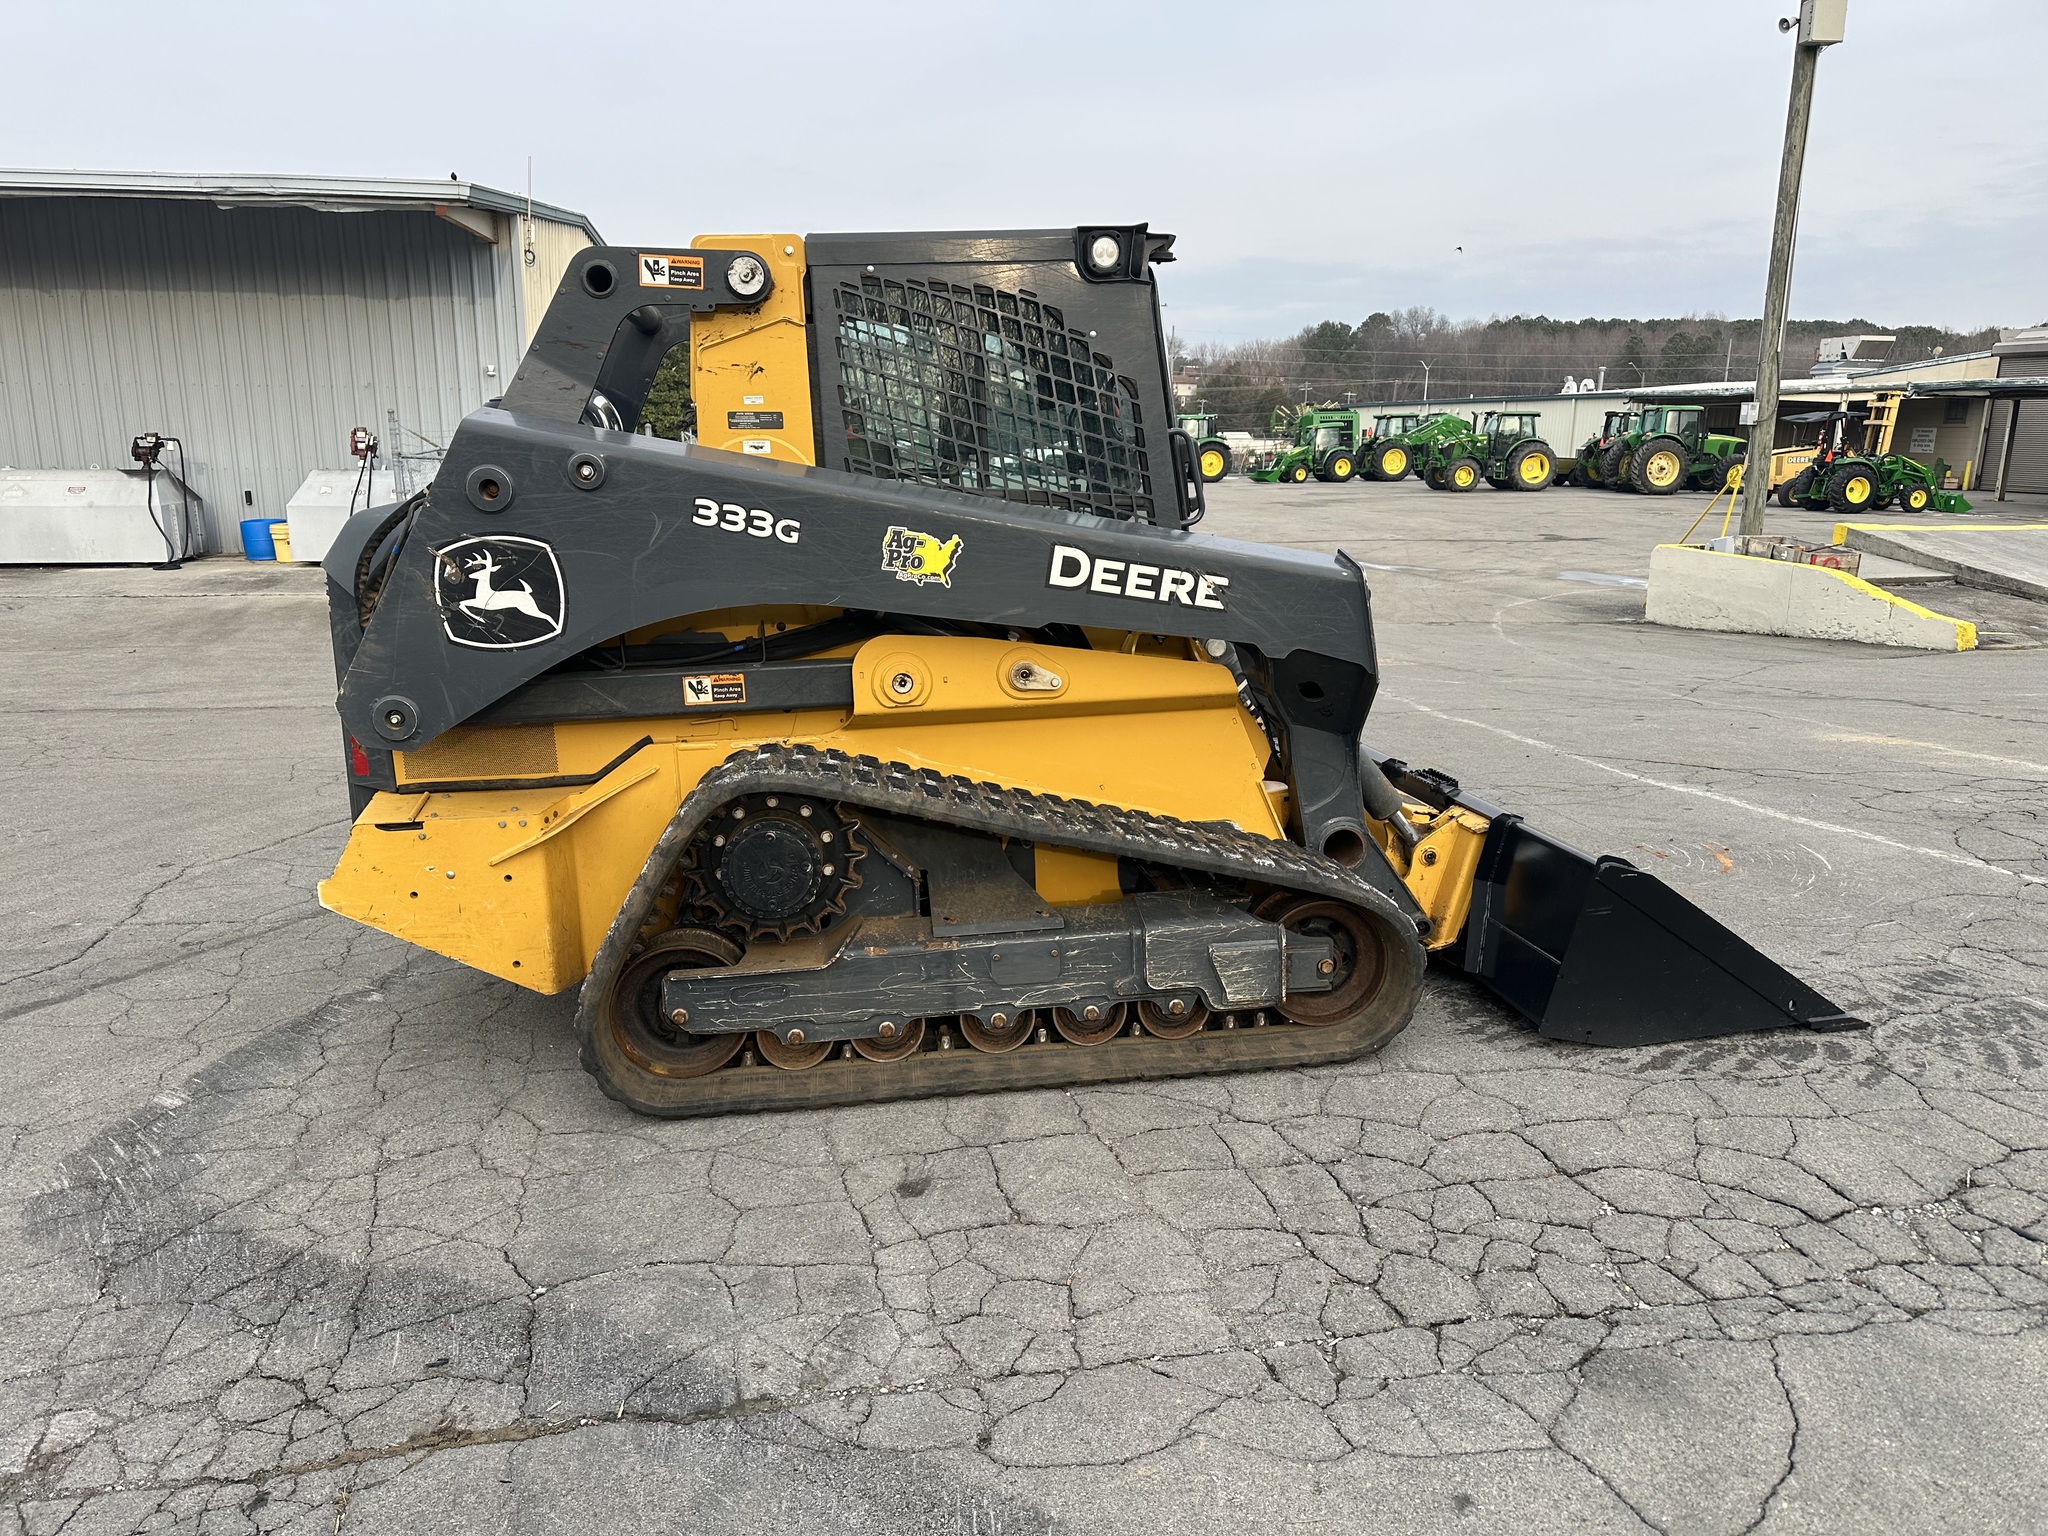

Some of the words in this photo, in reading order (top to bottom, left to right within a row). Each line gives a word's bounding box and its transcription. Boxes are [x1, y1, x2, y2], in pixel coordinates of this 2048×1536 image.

[692, 498, 801, 544] 333G
[887, 530, 924, 555] Ag-
[885, 549, 923, 569] Pro
[899, 572, 941, 581] AgProCo.com
[1049, 545, 1229, 610] DEERE
